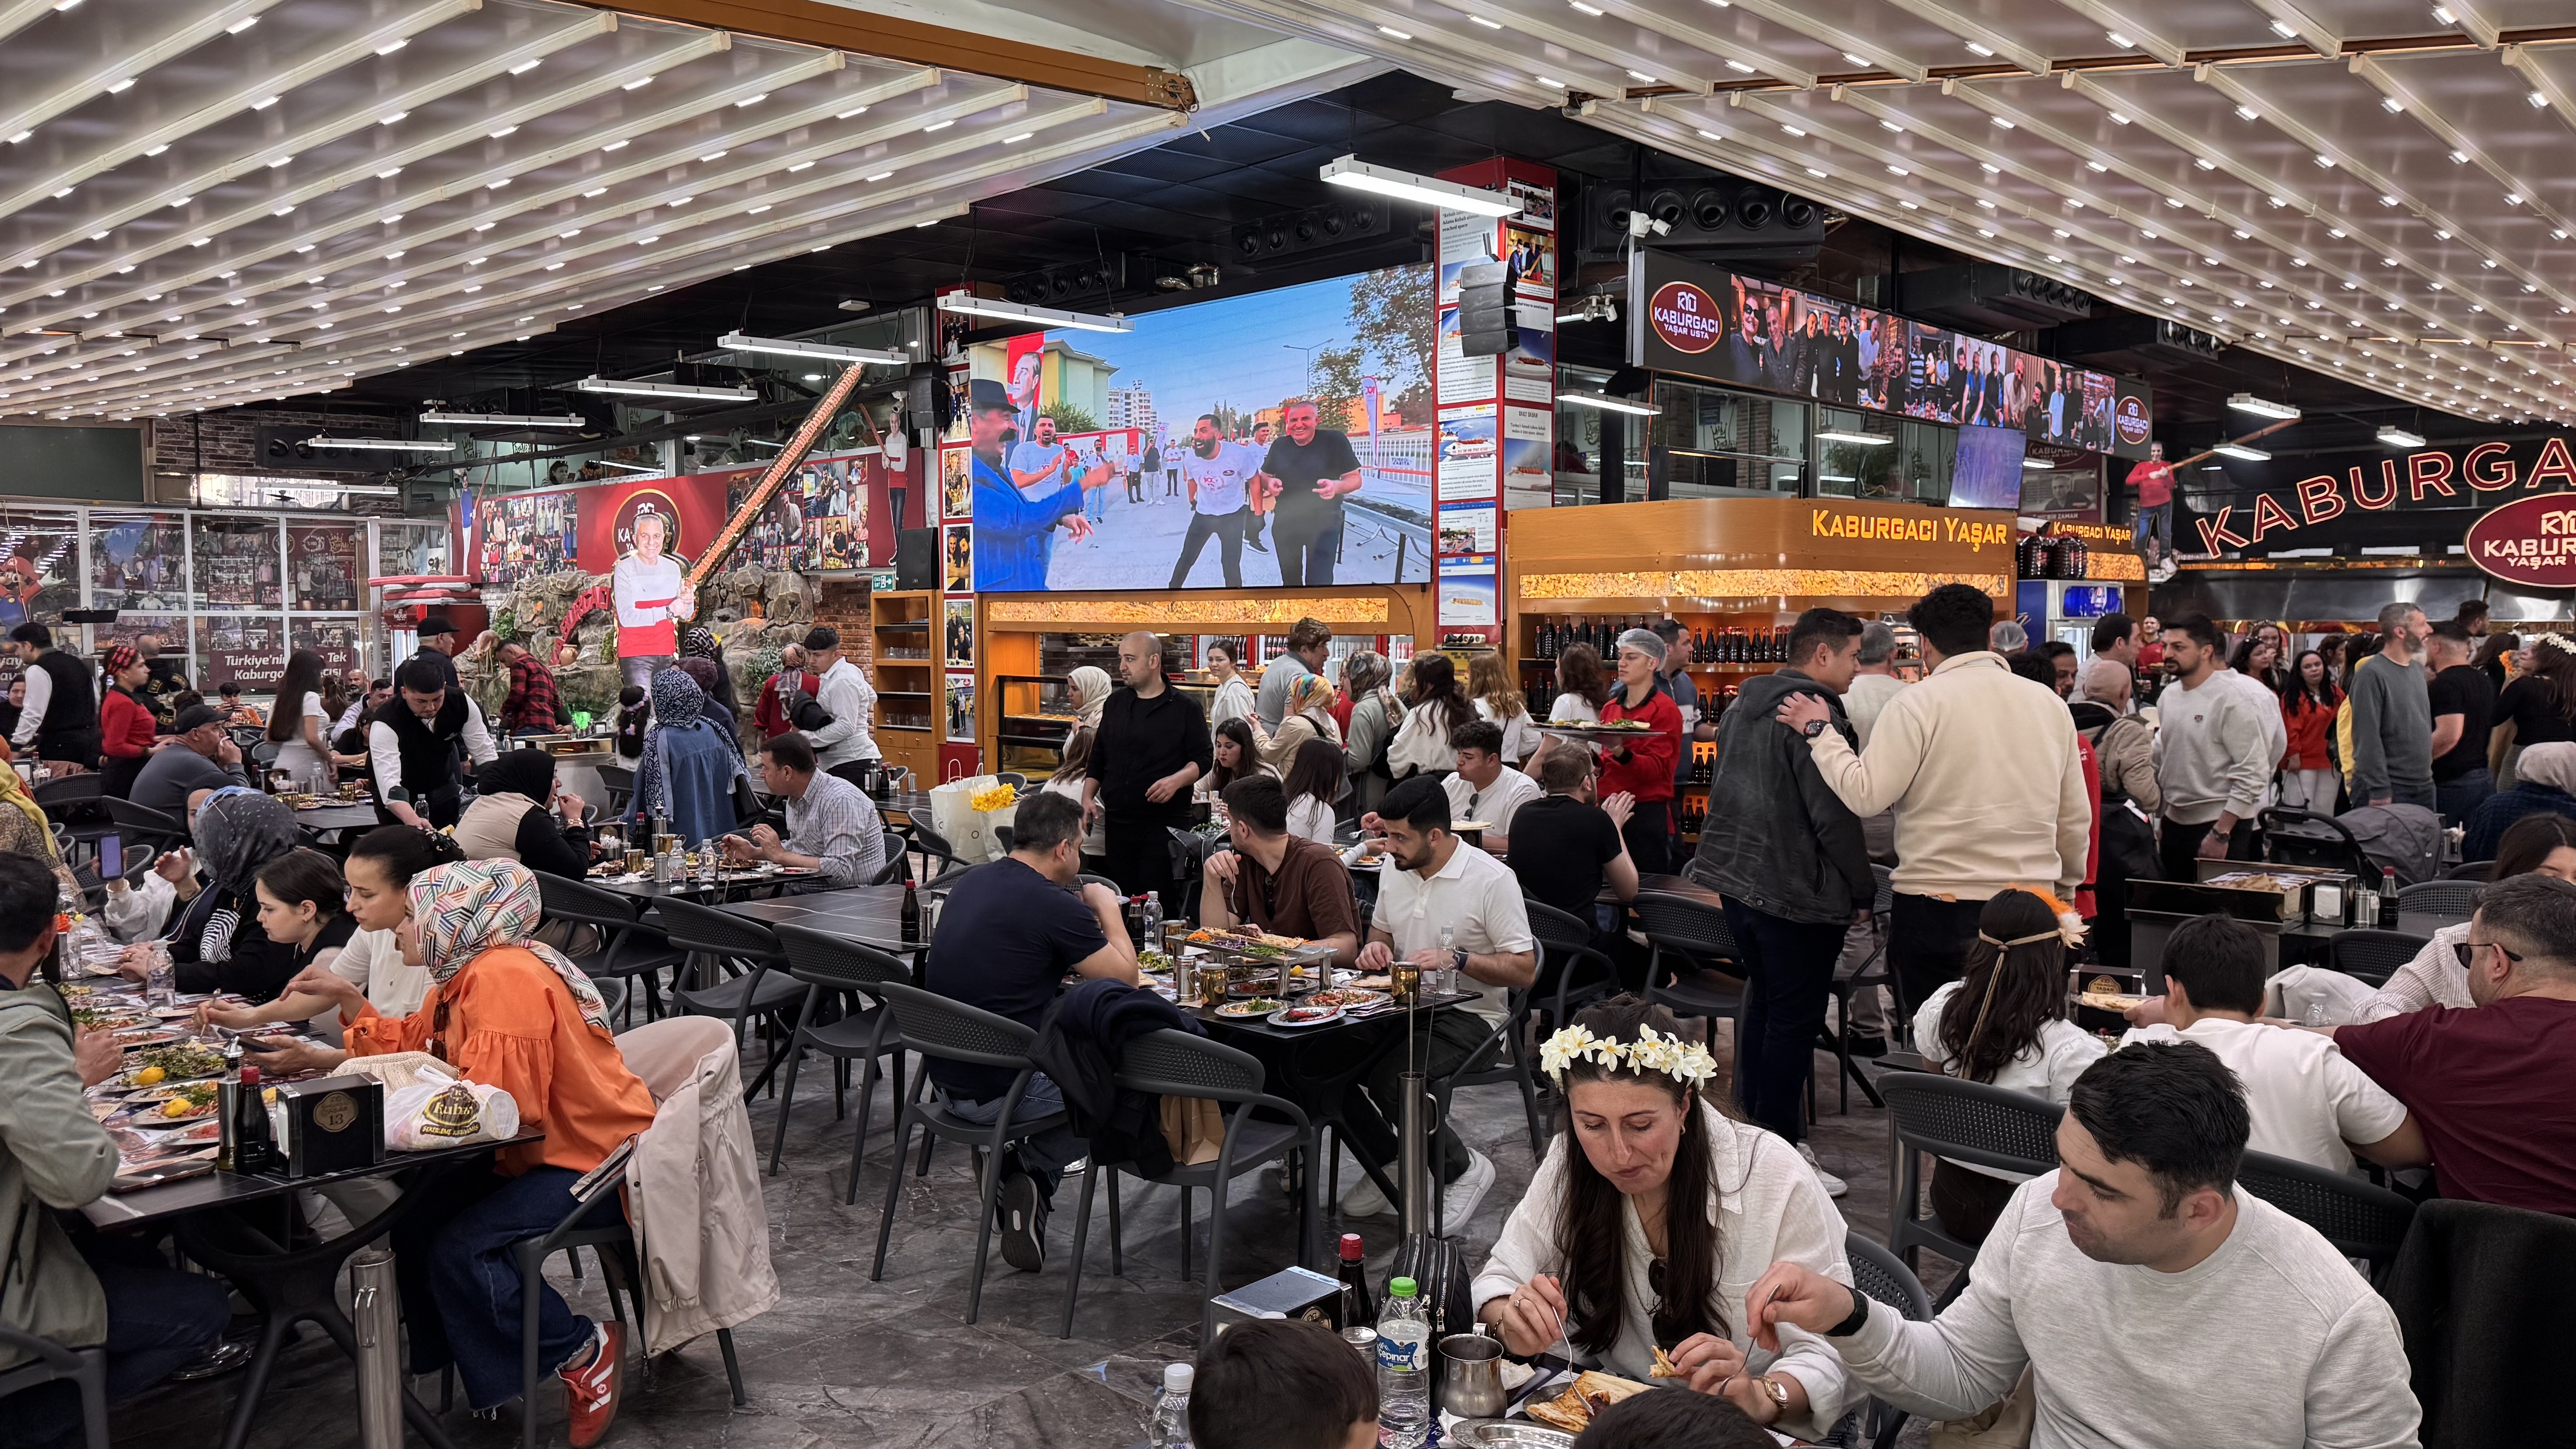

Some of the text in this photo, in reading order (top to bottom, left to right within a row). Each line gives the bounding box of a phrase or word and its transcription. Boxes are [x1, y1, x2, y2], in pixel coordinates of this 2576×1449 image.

[1654, 307, 1718, 333] KABURGACI
[1664, 323, 1709, 340] YAŞAR USTA
[1813, 509, 2007, 552] KABURGACI YAŞAR
[2105, 526, 2131, 545] YAŞAR
[2507, 556, 2567, 570] YAŞAR
[327, 652, 347, 662] Tek
[329, 1113, 343, 1126] 13
